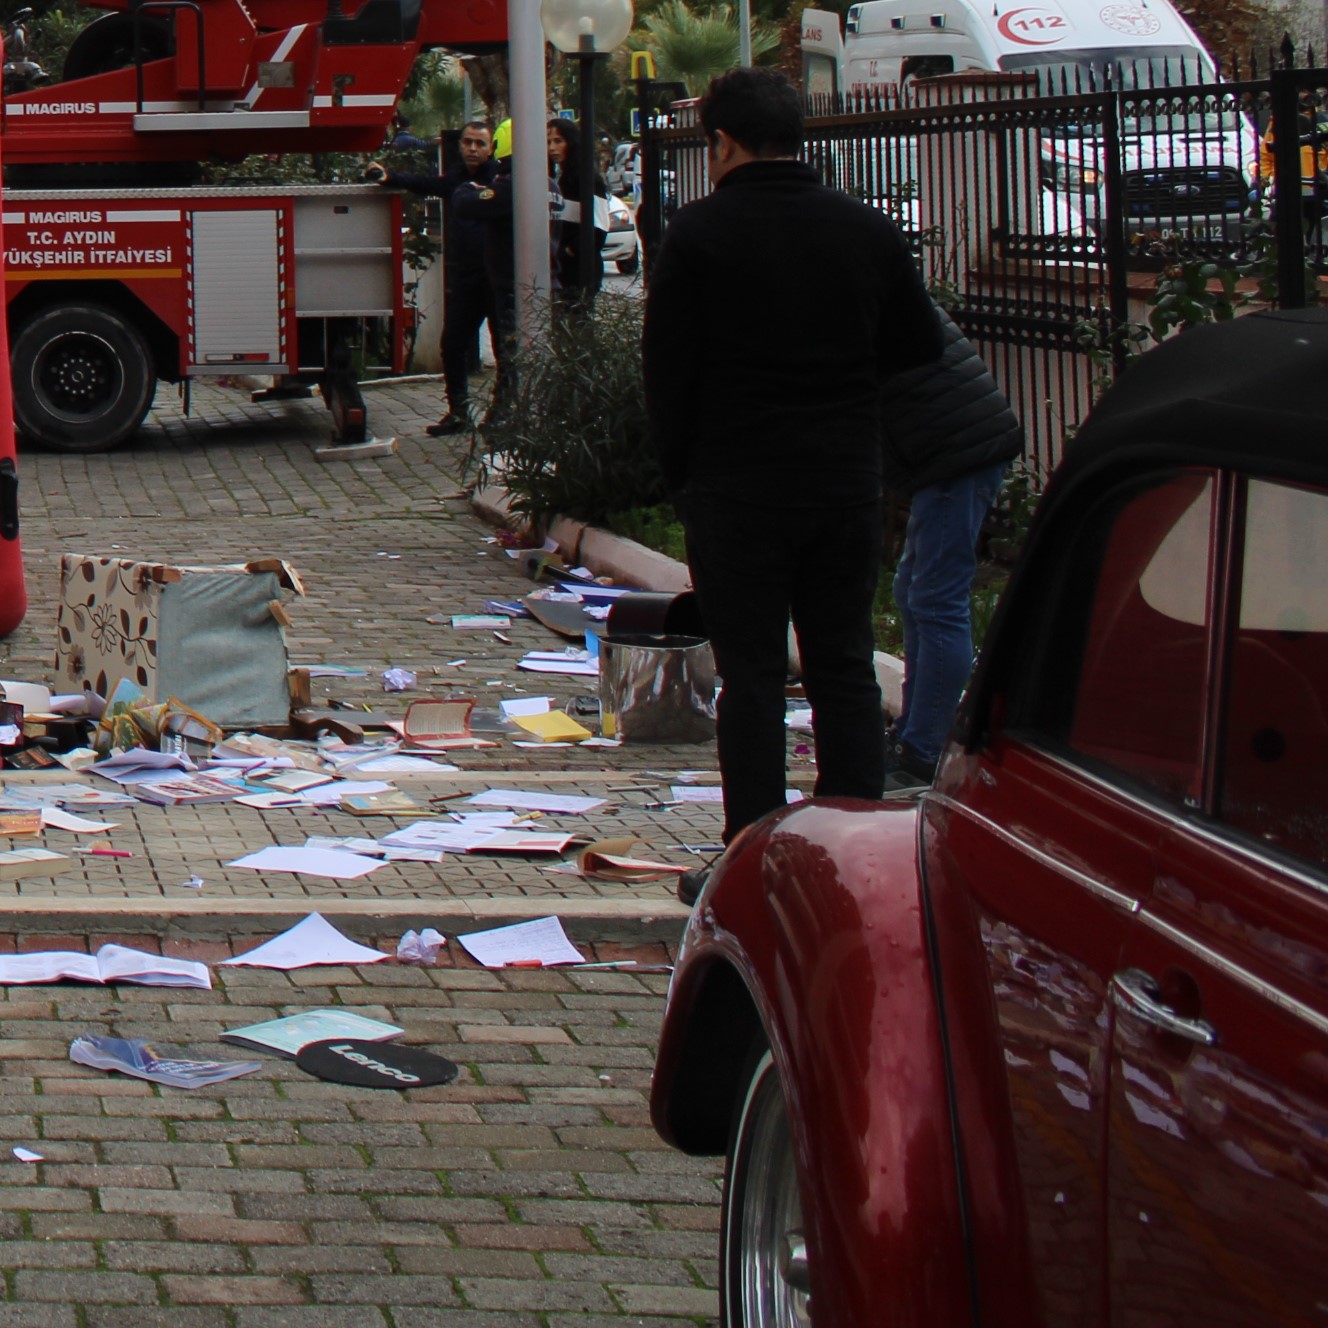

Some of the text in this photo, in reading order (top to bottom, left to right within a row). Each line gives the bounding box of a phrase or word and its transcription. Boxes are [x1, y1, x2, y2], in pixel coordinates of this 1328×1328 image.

[1014, 16, 1067, 31] 112
[26, 102, 96, 115] MAGIRUS
[29, 211, 102, 224] MAGIRUS
[27, 231, 116, 245] T.C. AYDIN
[90, 246, 172, 263] İTFAİYESİ
[329, 1044, 421, 1083] Lenco
